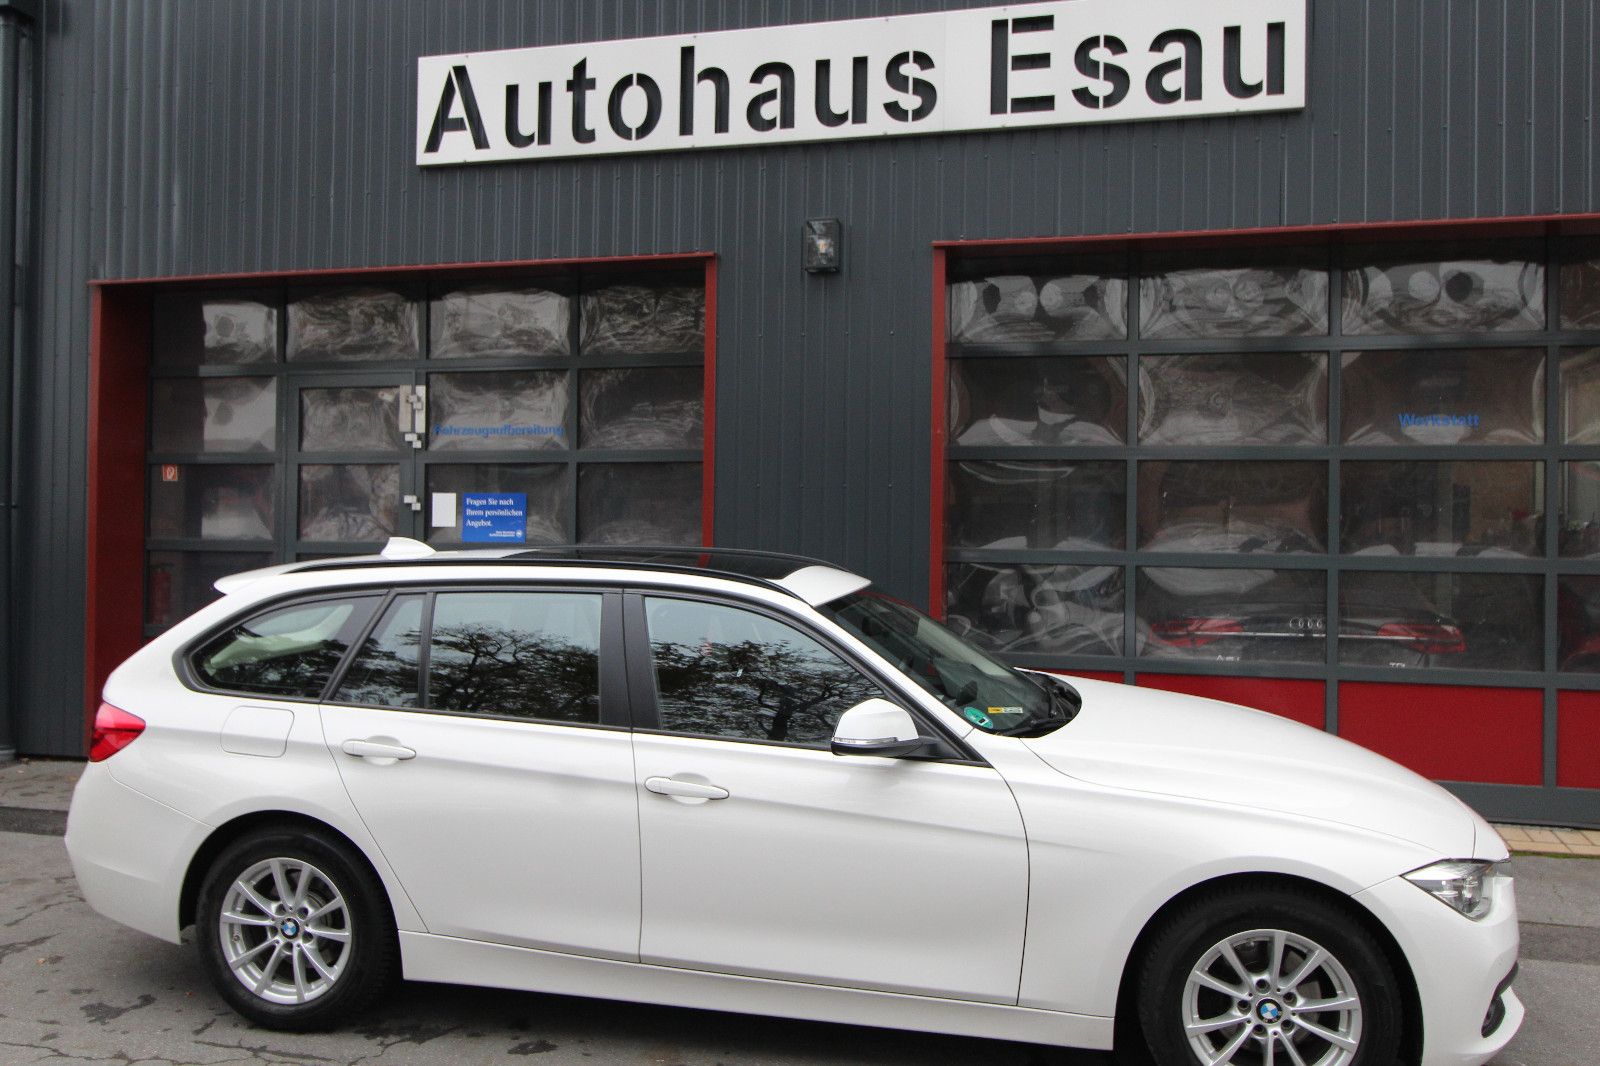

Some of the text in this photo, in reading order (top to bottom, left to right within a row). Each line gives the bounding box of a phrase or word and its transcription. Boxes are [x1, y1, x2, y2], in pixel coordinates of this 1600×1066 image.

[423, 14, 1286, 153] Autohaus Esau
[1398, 413, 1480, 428] Werkstatt
[433, 423, 565, 438] Fahrzeugaufbereitung
[466, 497, 514, 507] Fragen Sie nach
[466, 508, 523, 517] Ihrem persönlichen
[466, 519, 493, 528] Angebot.
